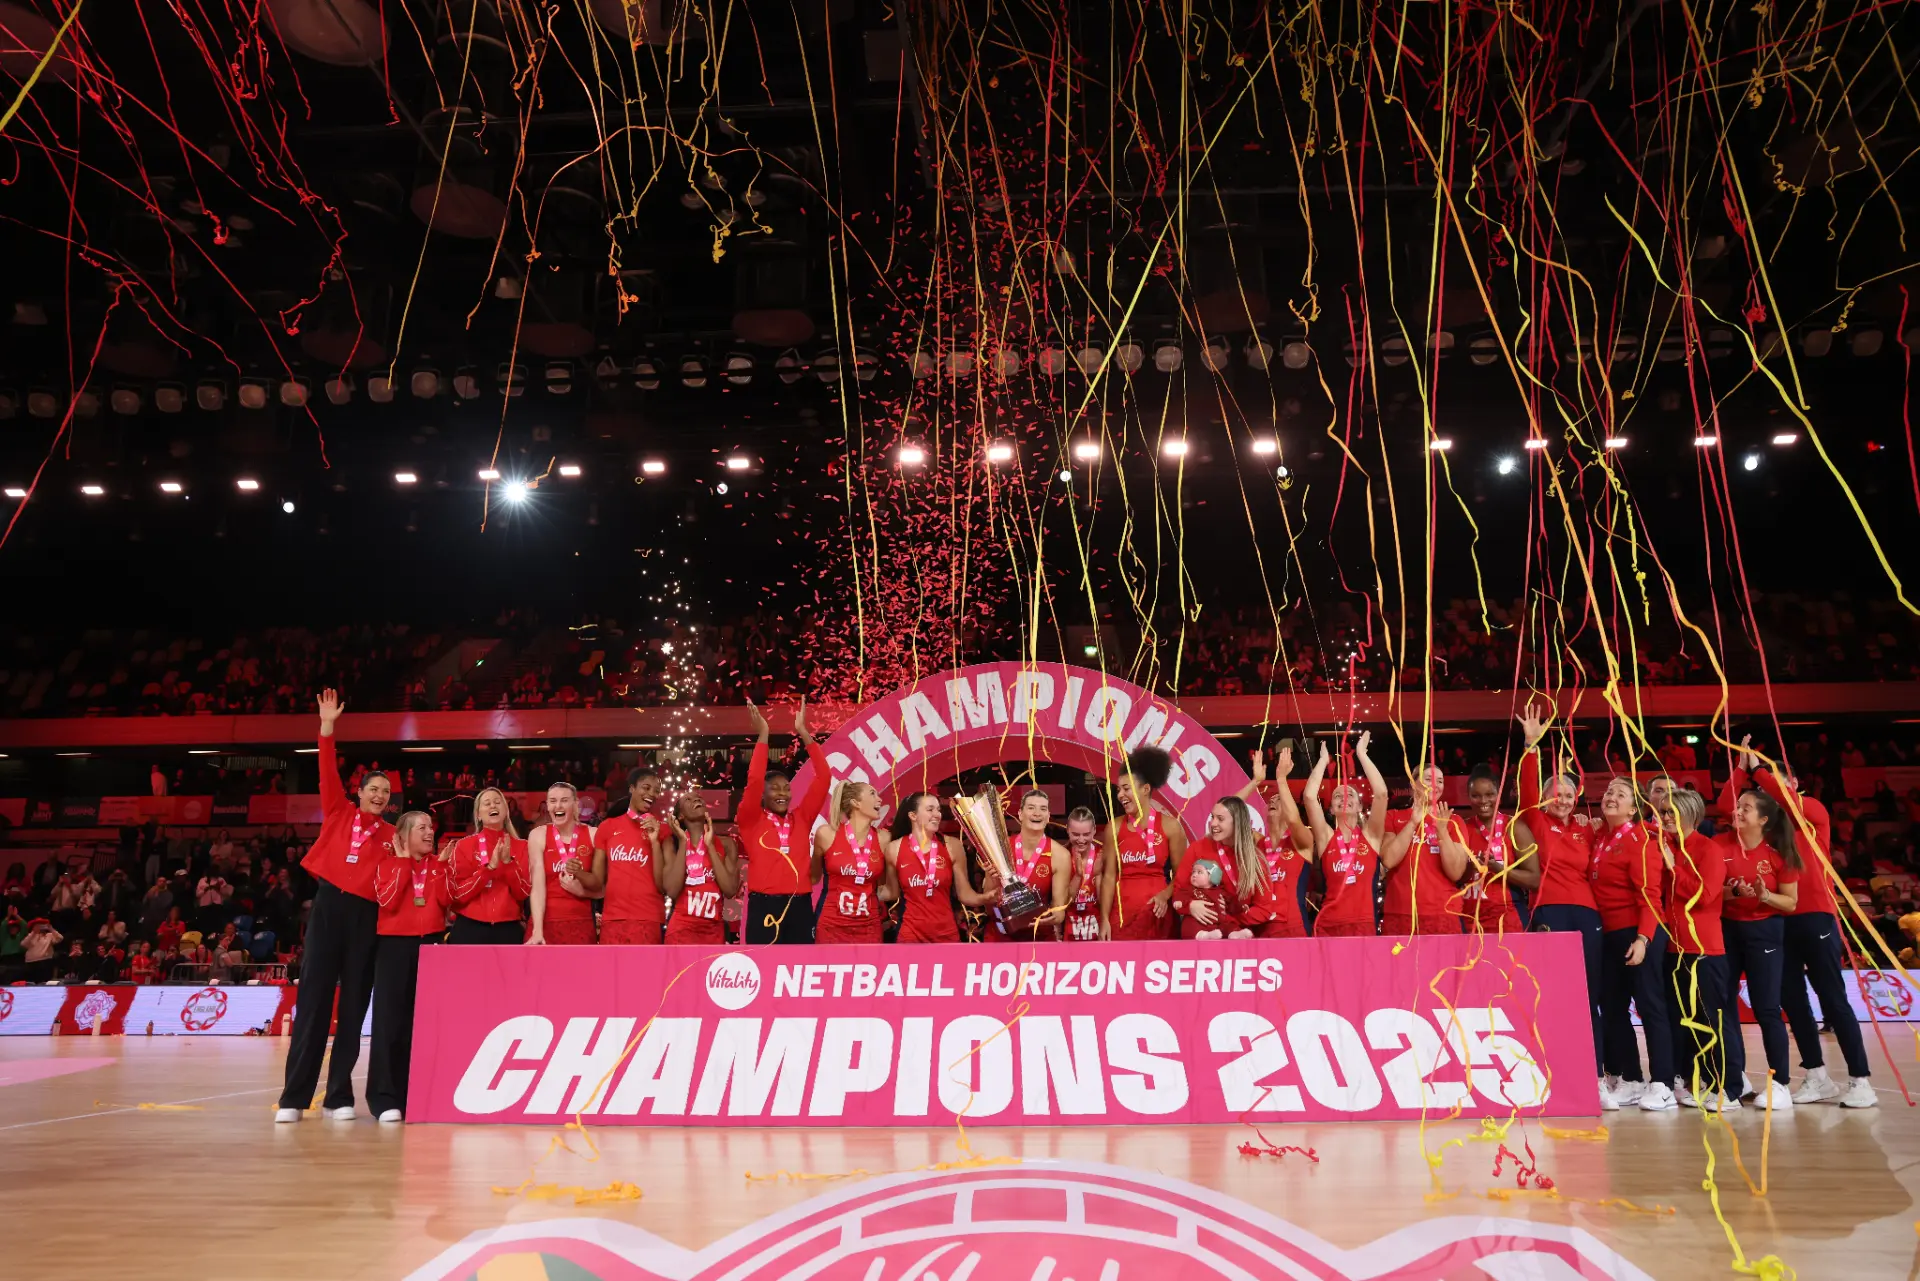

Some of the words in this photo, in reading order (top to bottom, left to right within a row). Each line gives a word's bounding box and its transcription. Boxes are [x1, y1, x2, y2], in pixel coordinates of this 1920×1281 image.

[828, 671, 1221, 799] CHAMPIONS
[610, 844, 648, 867] Vitality
[1121, 850, 1147, 863] Vitalit
[687, 890, 720, 918] WD
[839, 891, 870, 916] GA
[1070, 915, 1099, 940] WA
[709, 966, 760, 995] Vitality
[773, 963, 954, 998] NETBALL
[964, 961, 1135, 996] HORIZON
[1144, 958, 1283, 994] SERIES
[453, 1014, 1190, 1116] CHAMPIONS
[1206, 1007, 1551, 1113] 2025
